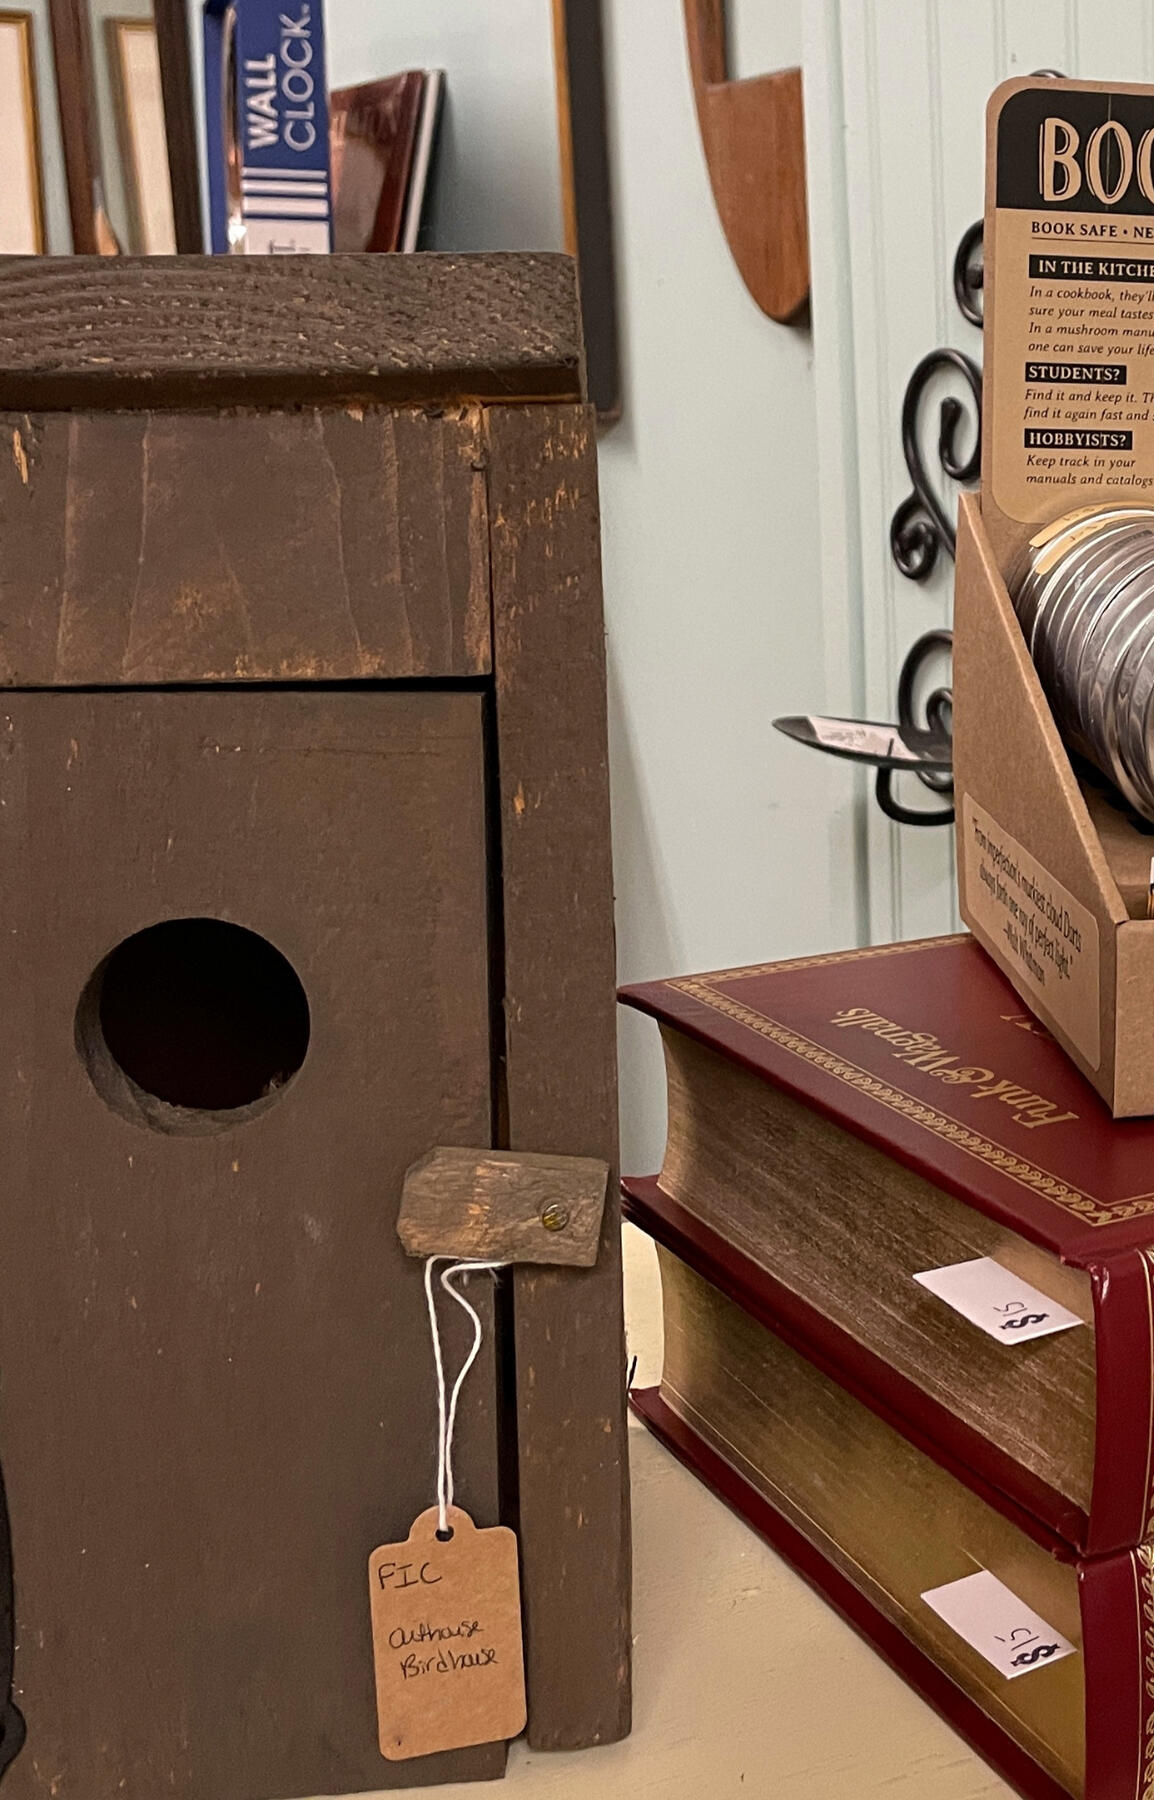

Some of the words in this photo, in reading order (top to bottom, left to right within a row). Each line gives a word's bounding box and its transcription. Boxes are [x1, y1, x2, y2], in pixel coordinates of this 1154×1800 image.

[278, 3, 316, 151] CLOCK.
[245, 53, 277, 149] WALL
[1032, 222, 1075, 236] BOOK
[1080, 223, 1118, 238] SAFE
[1039, 260, 1055, 273] IN
[1061, 261, 1093, 274] THE
[1030, 286, 1042, 297] In
[1057, 288, 1114, 302] cookbook,
[1029, 307, 1053, 316] sure
[1058, 308, 1084, 319] your
[1089, 308, 1117, 318] meal
[1121, 309, 1153, 320] tastes
[1029, 322, 1041, 333] In
[1045, 325, 1052, 333] a
[1056, 324, 1118, 335] mushroom
[1028, 343, 1049, 352] one
[1053, 344, 1073, 353] can
[1078, 345, 1103, 354] save
[1107, 345, 1133, 356] your
[1029, 365, 1120, 381] STUDENTS?
[1025, 389, 1052, 400] Find
[1056, 391, 1065, 400] it
[1069, 390, 1091, 401] and
[1095, 391, 1121, 404] keep
[1023, 407, 1049, 420] find
[1052, 409, 1061, 419] it
[1065, 410, 1096, 422] again
[1100, 410, 1122, 422] fast
[1126, 410, 1148, 421] and
[1030, 432, 1126, 446] HOBBYISTS?
[1027, 455, 1055, 468] Keep
[1060, 456, 1089, 467] track
[1094, 457, 1105, 467] in
[1109, 458, 1135, 470] your
[1026, 473, 1077, 484] manuals
[1080, 474, 1102, 485] and
[1107, 475, 1153, 488] catalogs
[830, 1008, 960, 1077] Wagnalls
[970, 1080, 1079, 1129] Funk
[378, 1562, 442, 1590] FIC
